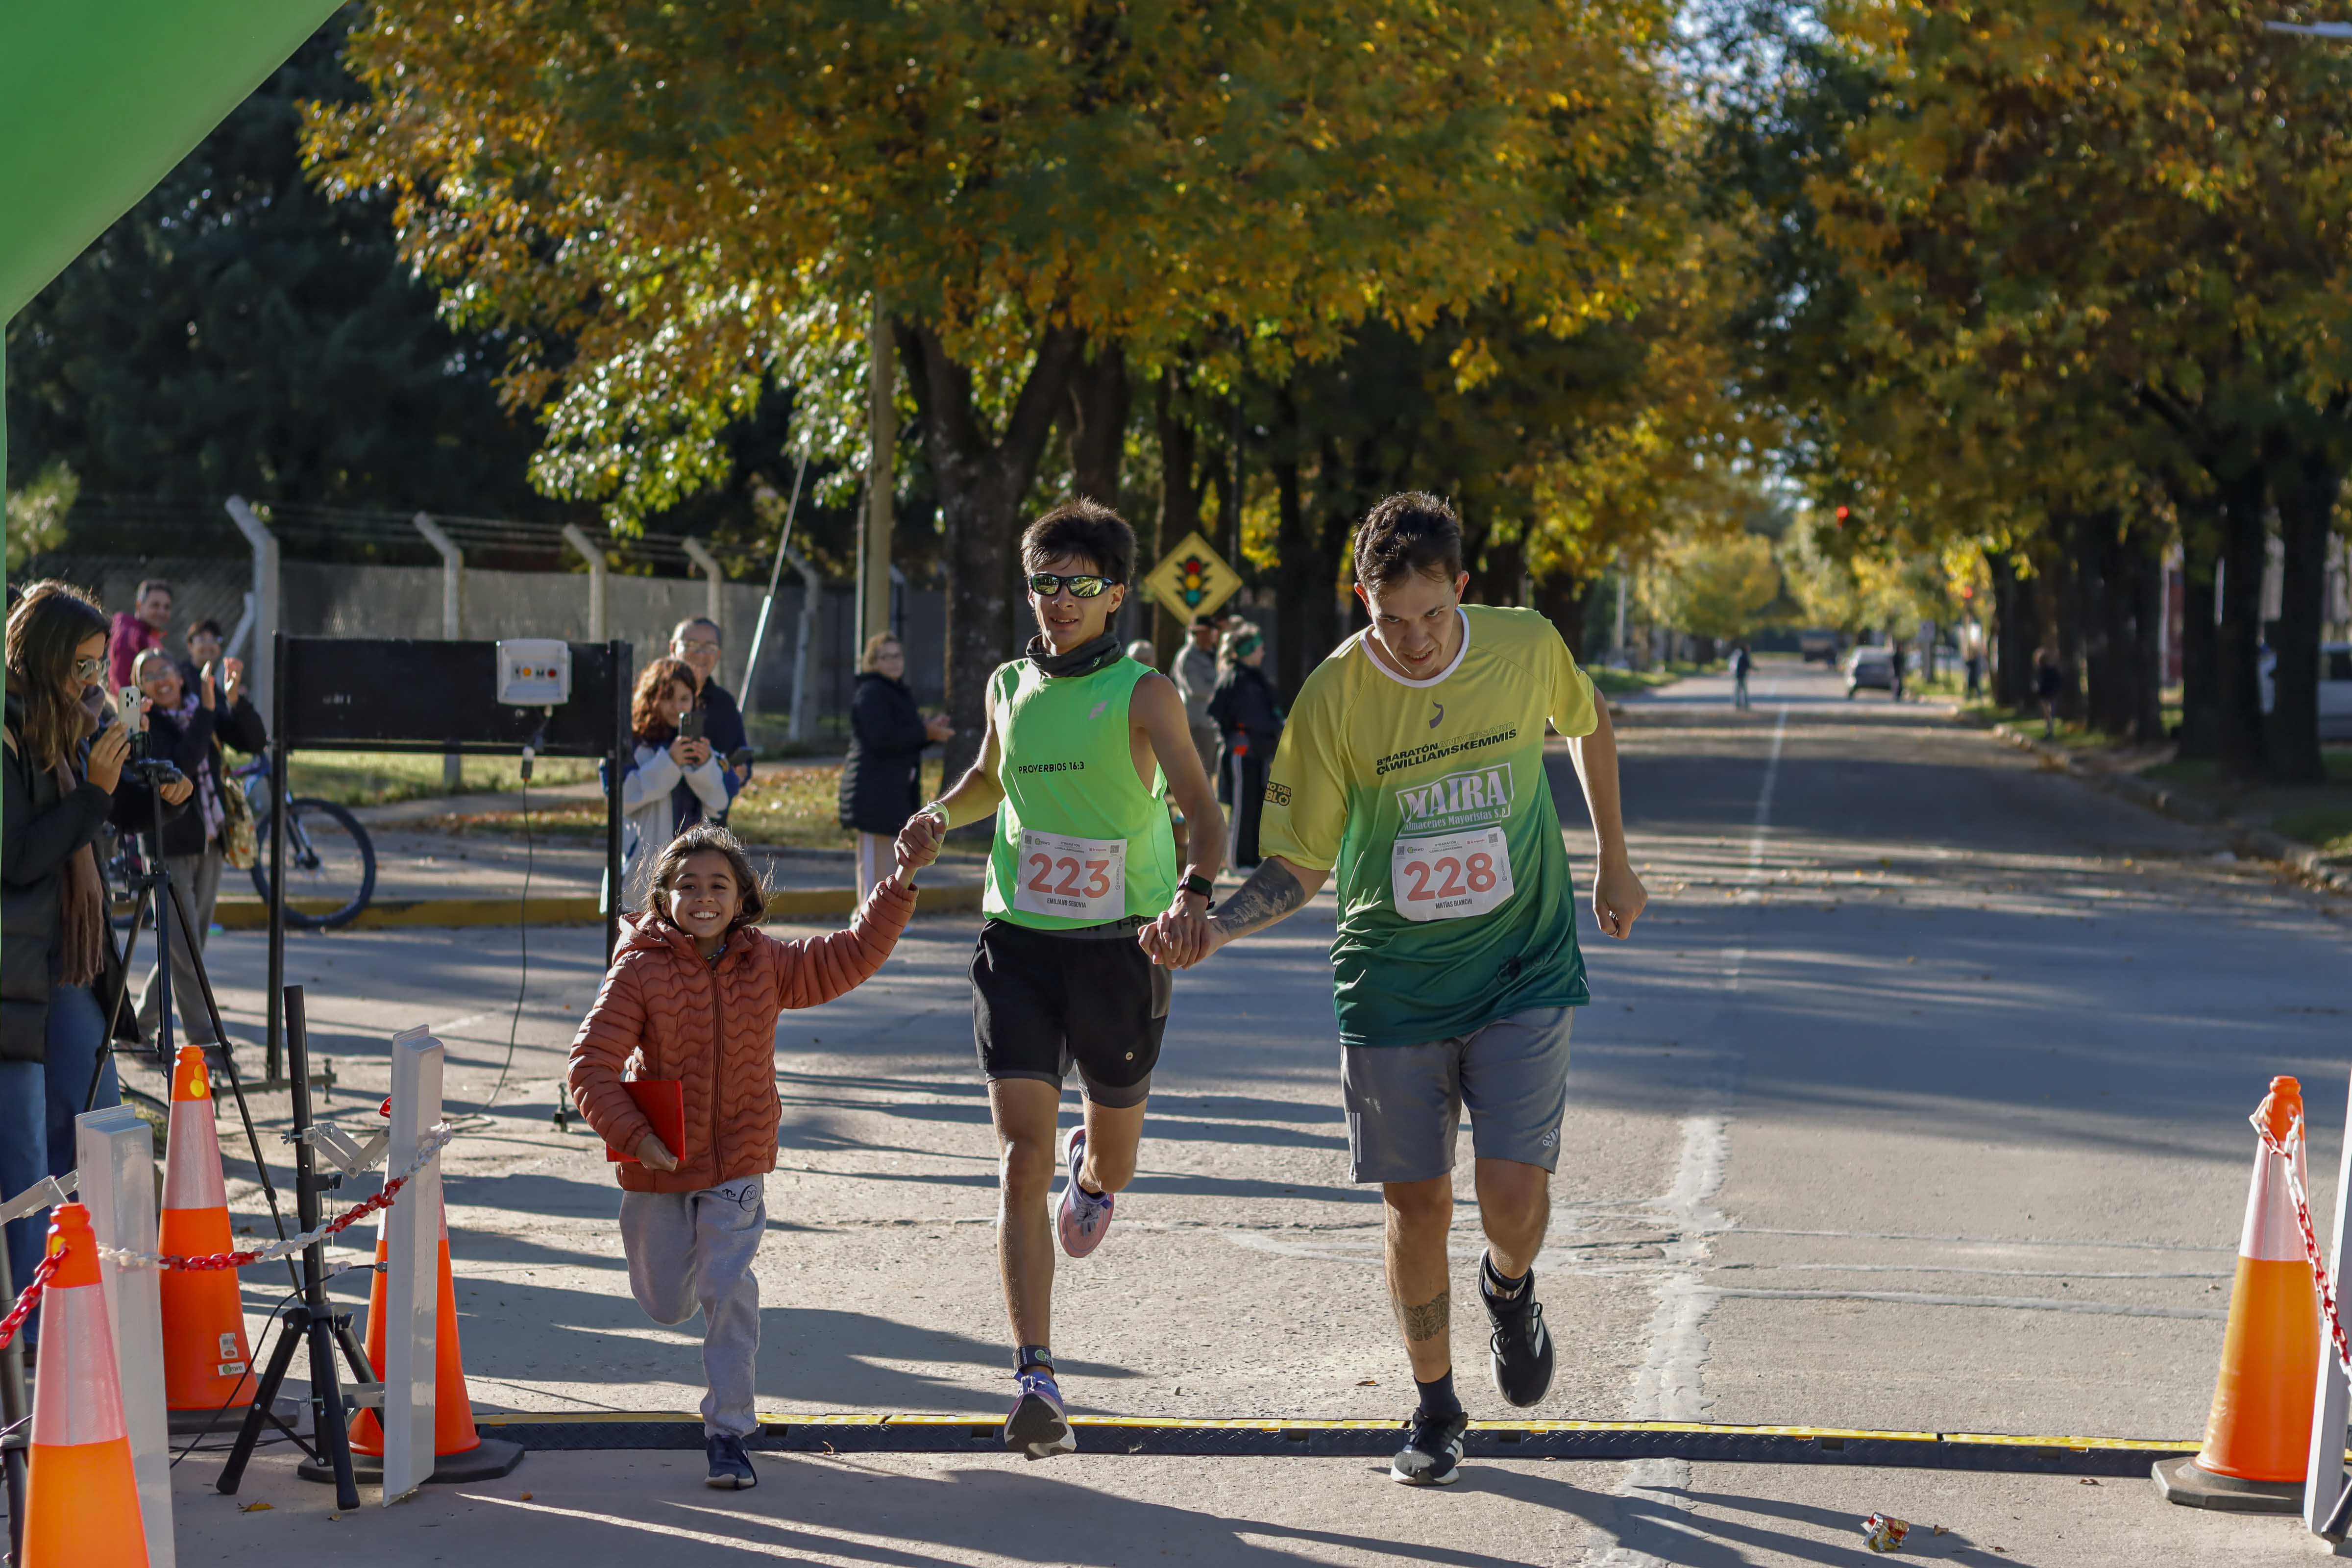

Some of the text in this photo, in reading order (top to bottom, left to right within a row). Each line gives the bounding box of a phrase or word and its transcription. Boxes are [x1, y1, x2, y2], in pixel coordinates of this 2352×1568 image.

[1018, 761, 1084, 774] PROVERBIOS 16:3
[1277, 785, 1291, 796] DEL
[1404, 771, 1507, 818] MAIRA
[1404, 818, 1446, 831] Almacenes
[1448, 811, 1492, 825] Mayoristas
[1028, 853, 1110, 898] 223
[1403, 853, 1496, 901] 228
[1435, 898, 1472, 909] MATÍAS BIANCHI
